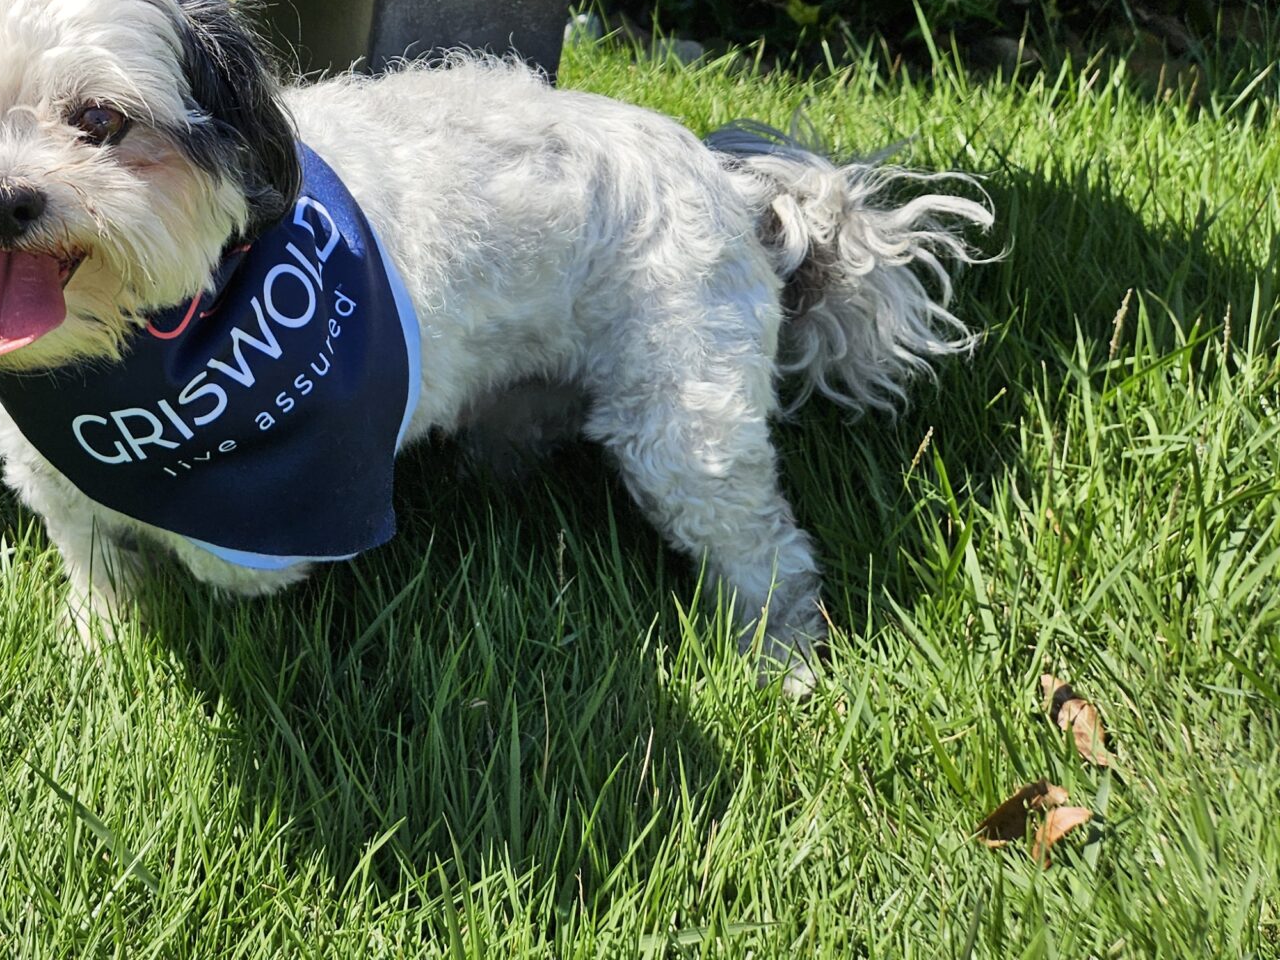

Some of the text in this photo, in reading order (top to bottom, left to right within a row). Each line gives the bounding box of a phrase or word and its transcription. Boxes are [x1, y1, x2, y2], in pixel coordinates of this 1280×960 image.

[72, 195, 341, 465] GRISWOLD
[163, 288, 358, 477] live assured
